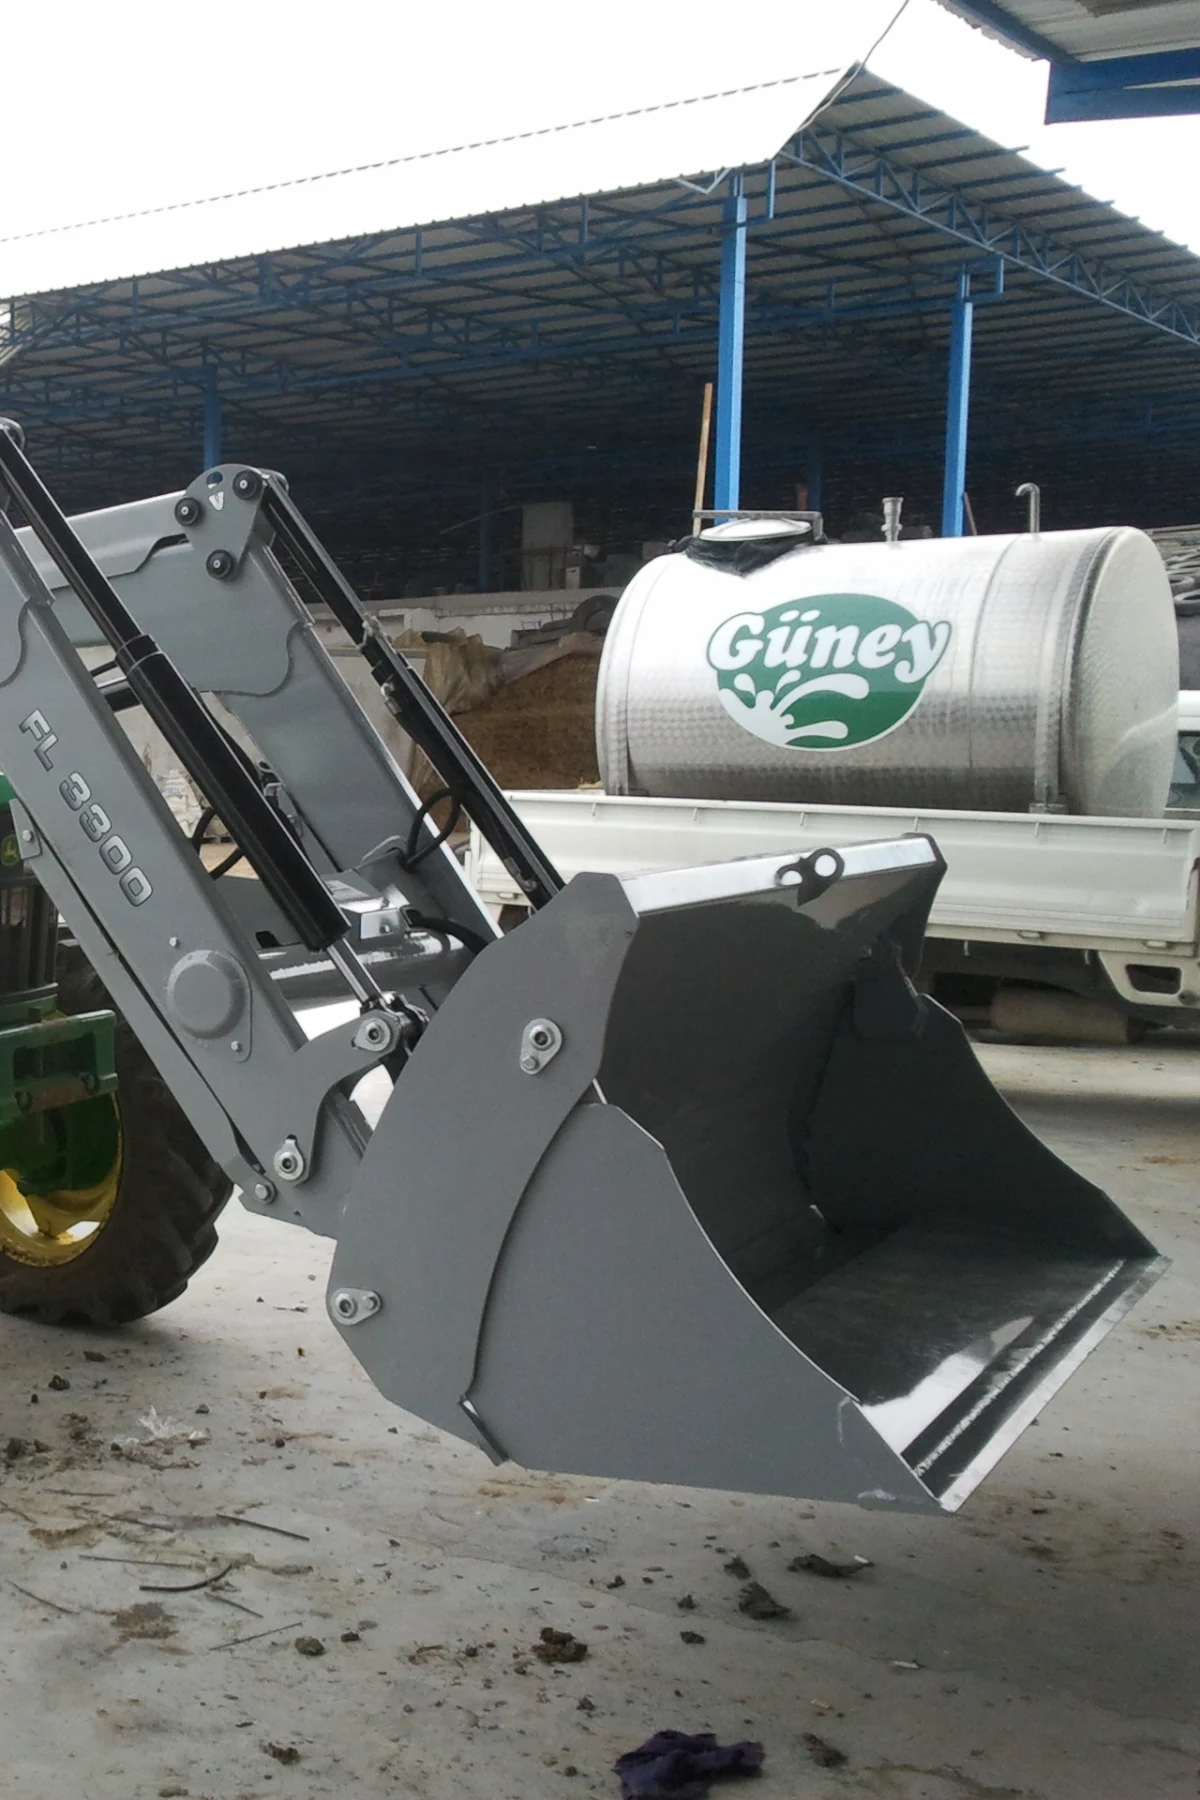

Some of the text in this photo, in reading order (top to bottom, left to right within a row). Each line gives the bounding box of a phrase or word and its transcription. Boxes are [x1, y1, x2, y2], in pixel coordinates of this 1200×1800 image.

[707, 609, 952, 684] Güney
[19, 708, 154, 908] FL 3300
